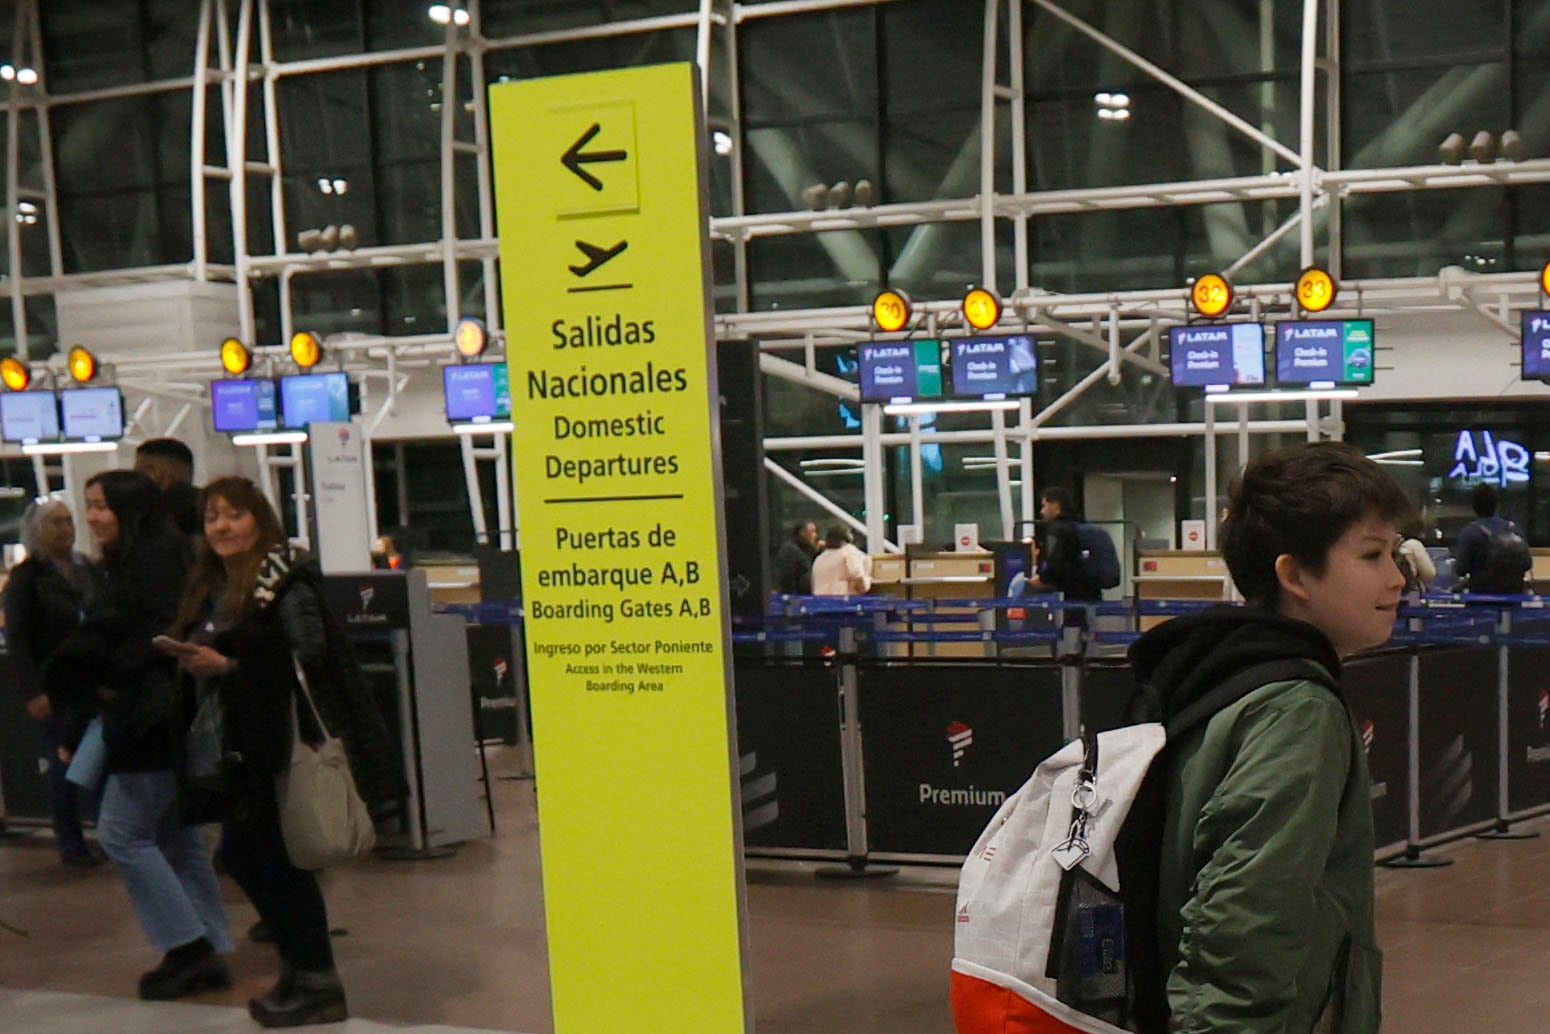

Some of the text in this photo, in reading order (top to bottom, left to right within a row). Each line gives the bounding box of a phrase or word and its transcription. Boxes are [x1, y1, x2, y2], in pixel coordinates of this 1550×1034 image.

[1200, 285, 1223, 304] 32
[1302, 280, 1326, 299] 33
[552, 313, 656, 350] Salidas
[1187, 331, 1228, 341] LATAM
[1294, 328, 1337, 338] LATAM
[528, 361, 688, 400] Nacionales
[554, 410, 665, 440] Domestic
[545, 454, 679, 484] Departures
[556, 523, 676, 550] Puertas de
[538, 561, 700, 592] embarque A,B
[532, 598, 711, 623] Boarding Gates A,B
[534, 640, 713, 658] Ingreso por Sector Poniente
[565, 663, 683, 675] Access in the Western
[586, 681, 664, 694] Boarding Area
[919, 783, 1007, 806] Premium
